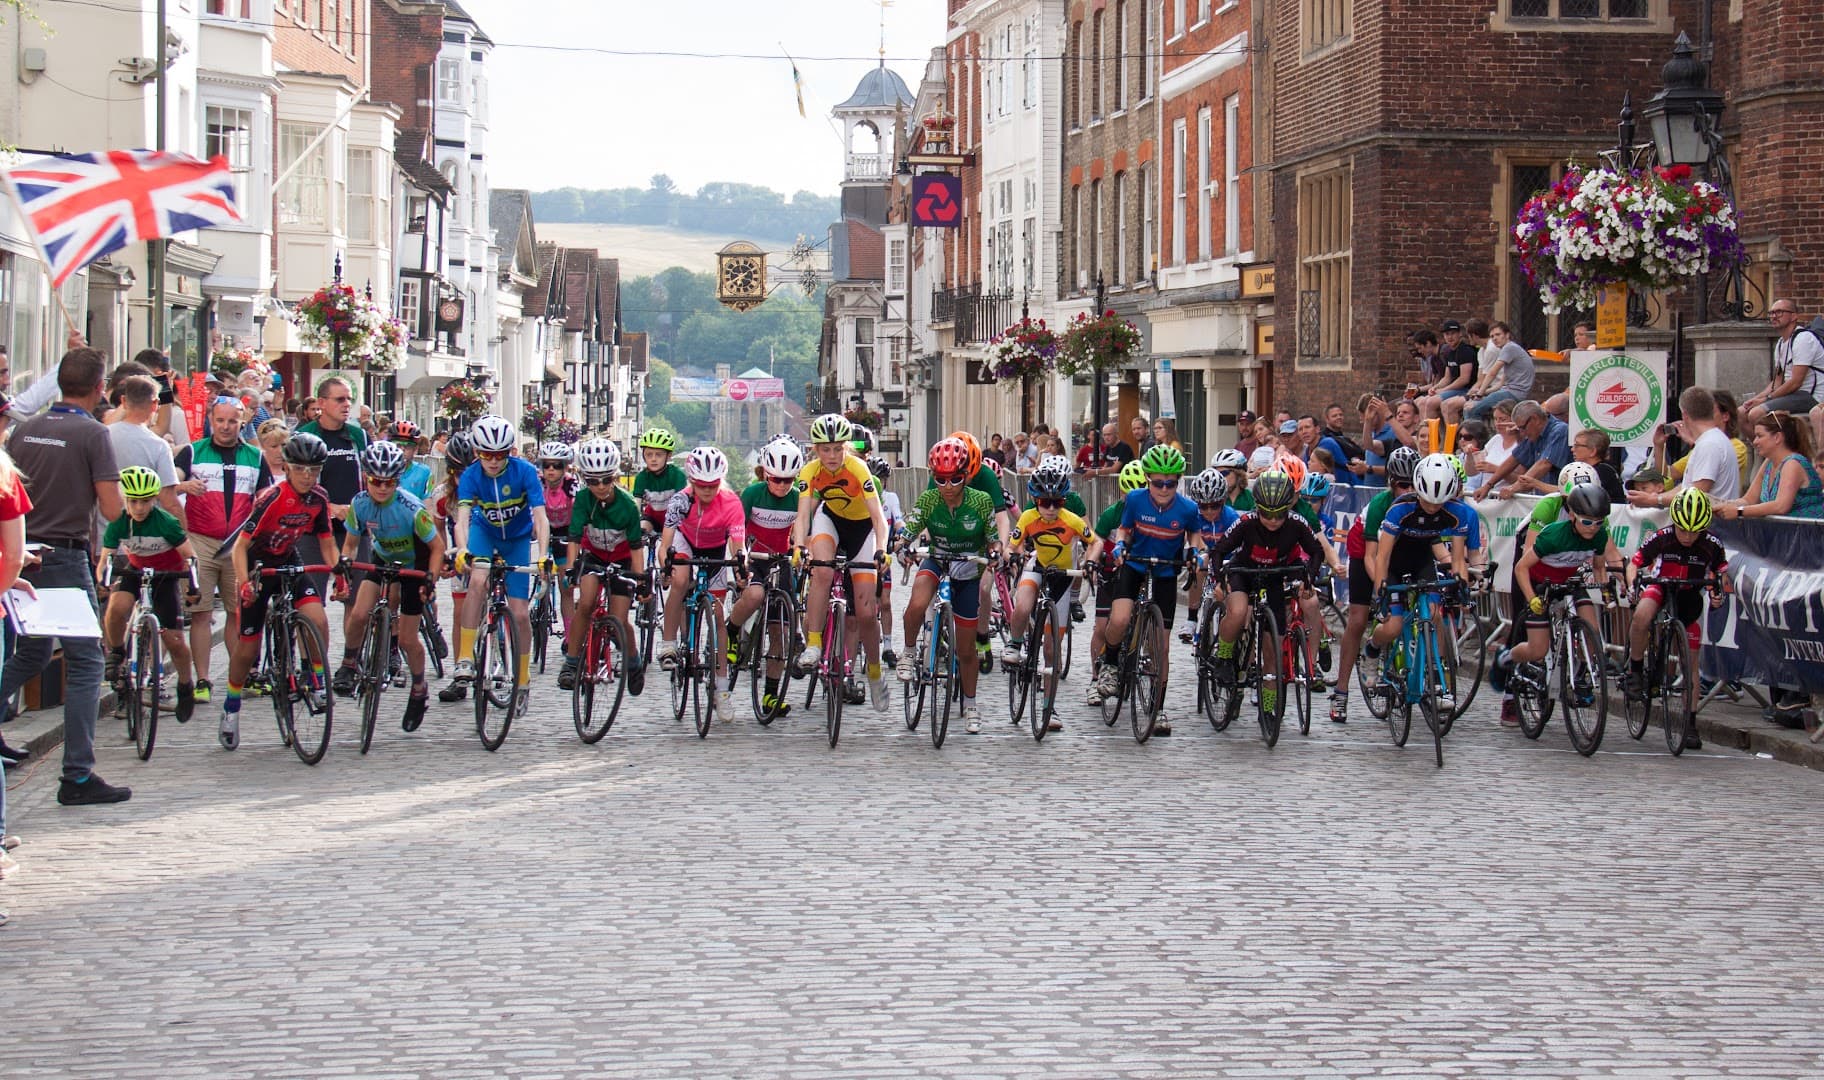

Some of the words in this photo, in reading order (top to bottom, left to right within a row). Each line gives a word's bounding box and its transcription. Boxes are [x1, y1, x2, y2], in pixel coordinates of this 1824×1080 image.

[1577, 357, 1658, 389] CHARLOTTEVILLE
[1582, 418, 1625, 441] CYNG
[1628, 418, 1654, 439] CLUB
